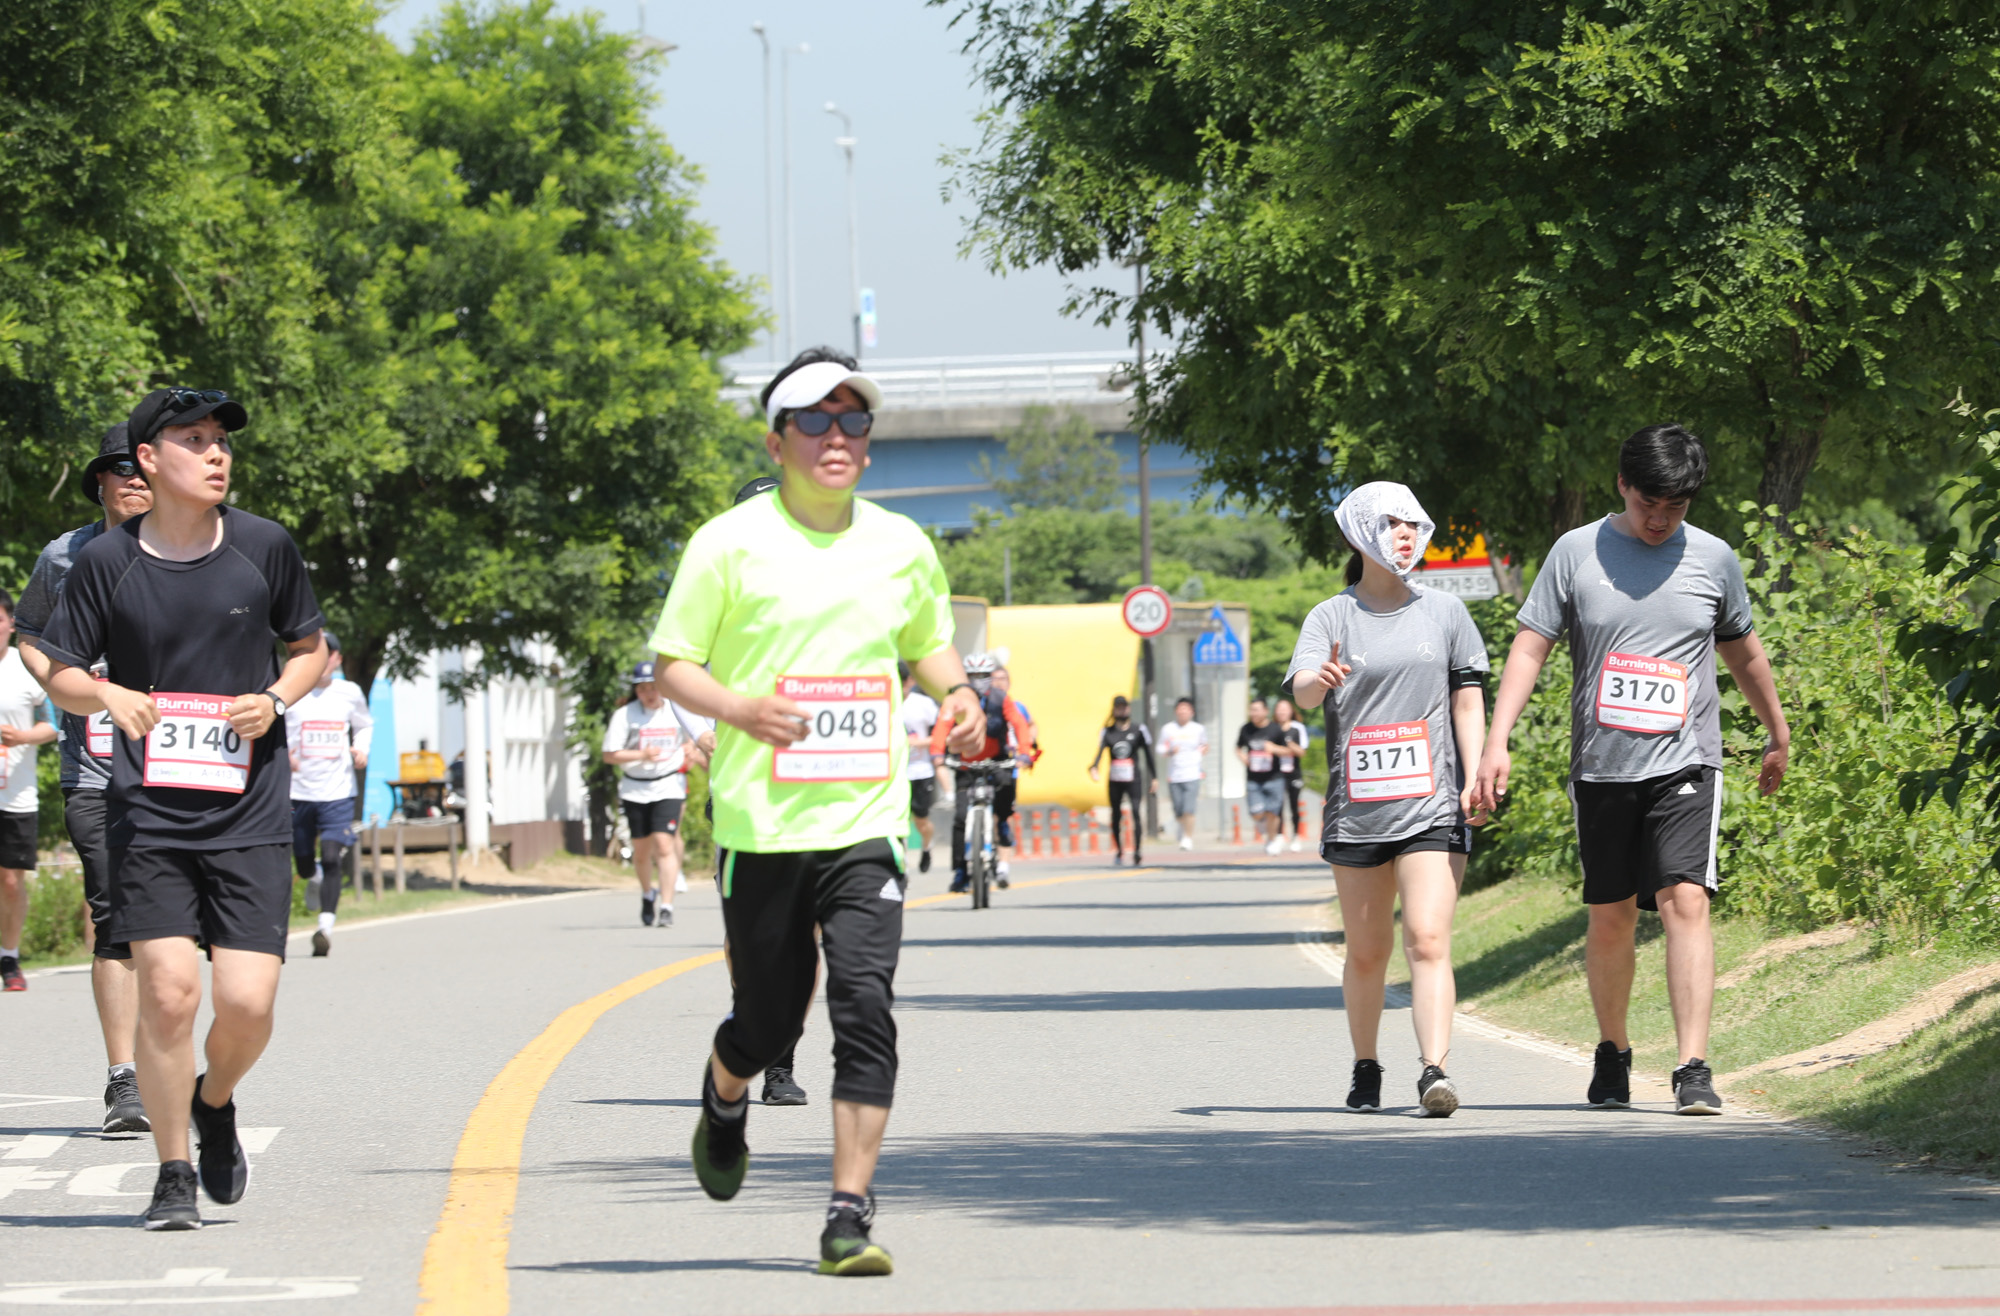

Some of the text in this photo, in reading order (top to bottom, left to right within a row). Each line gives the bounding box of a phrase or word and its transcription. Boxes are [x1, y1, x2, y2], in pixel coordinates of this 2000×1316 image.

[1133, 601, 1162, 622] 20
[1608, 656, 1657, 672] Burning
[1658, 663, 1682, 676] Run
[784, 679, 886, 697] Burning Run
[1610, 677, 1676, 704] 3170
[156, 697, 219, 714] Burning
[799, 709, 877, 738] 048
[1351, 726, 1422, 740] Burning Run
[160, 722, 241, 754] 3140
[1356, 746, 1416, 771] 3171
